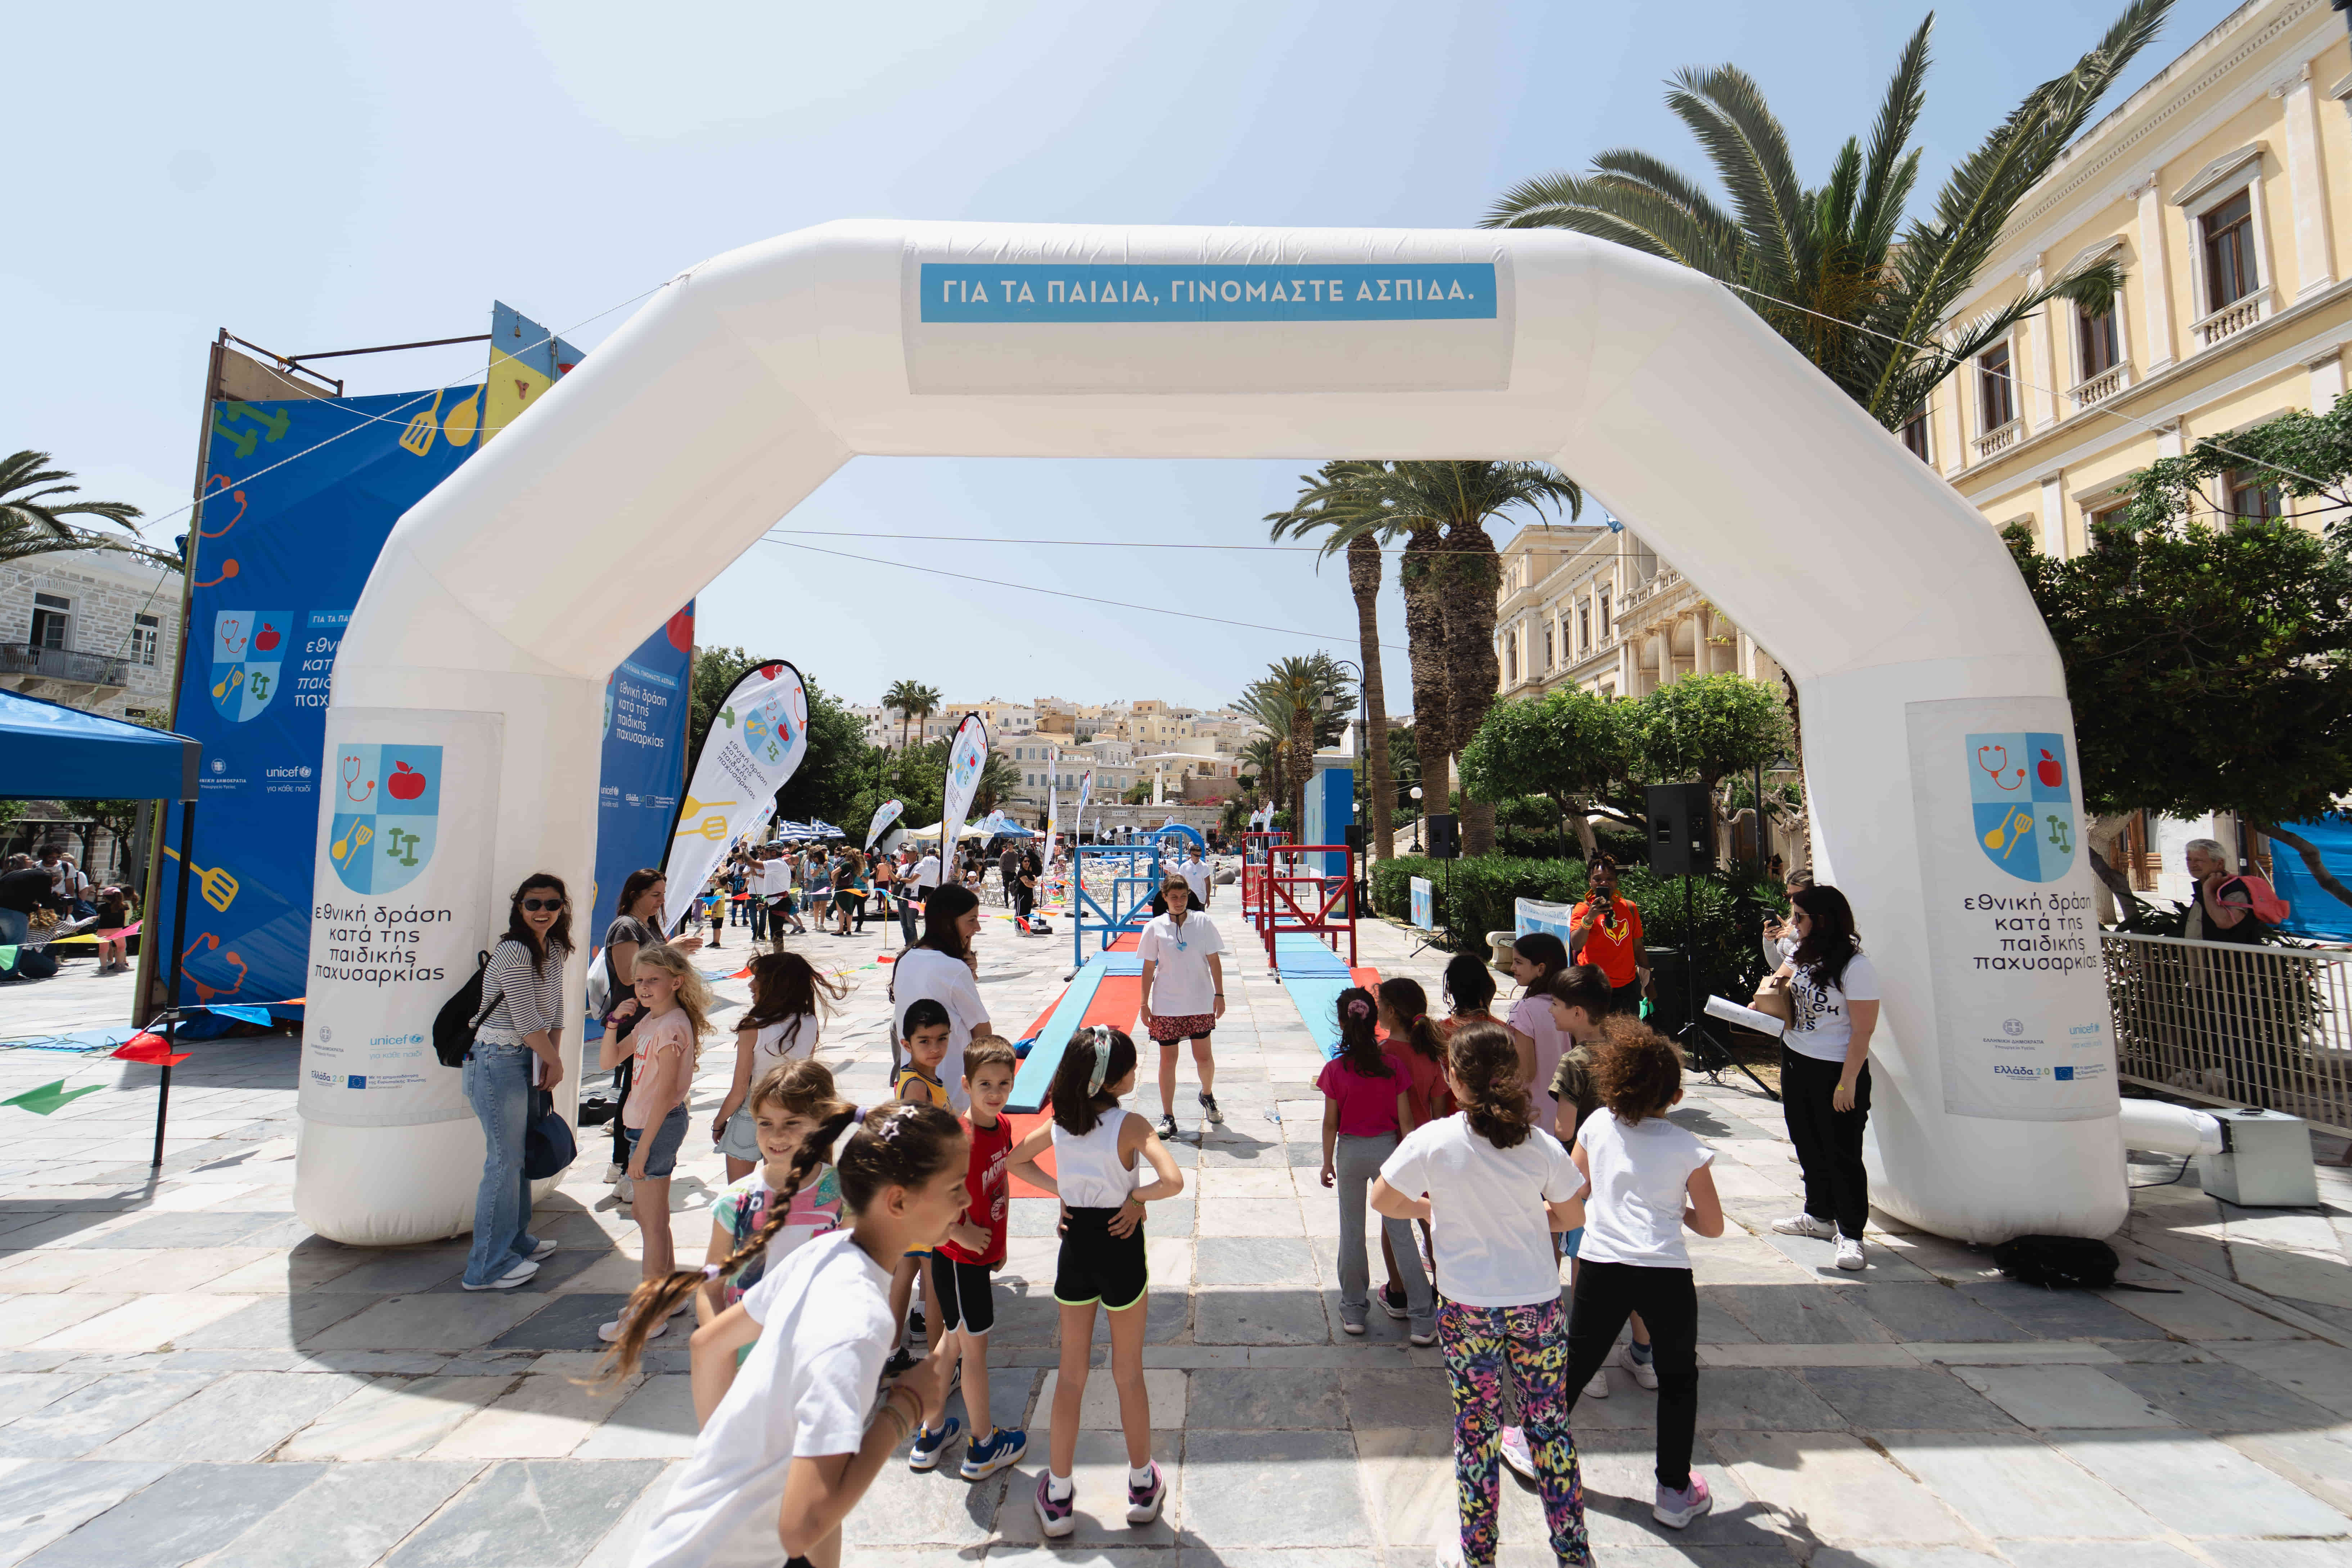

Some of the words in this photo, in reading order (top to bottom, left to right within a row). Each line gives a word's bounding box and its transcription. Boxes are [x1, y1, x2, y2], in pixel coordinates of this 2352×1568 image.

[943, 280, 989, 303] ΓΙΑ
[1000, 280, 1035, 303] ΤΑ
[1048, 281, 1159, 306] ΠΑΙΔΙΑ,
[1172, 280, 1344, 303] ΓΙΝΟΜΑΣΤΕ
[1355, 278, 1475, 301] ΑΣΠΙΔΑ.
[306, 637, 342, 653] εθνι
[302, 659, 333, 671] κατ
[297, 673, 332, 689] παιδ
[294, 694, 329, 707] παχ
[619, 681, 640, 699] εθνική
[642, 689, 667, 707] δράση
[618, 698, 634, 712] κατά
[636, 704, 649, 717] της
[617, 714, 646, 731] παιδικής
[616, 728, 664, 748] παχυσαρκίας
[721, 750, 747, 780] παιδικής
[725, 745, 742, 763] κατά
[742, 763, 753, 776] της
[729, 740, 749, 763] εθνική
[749, 763, 767, 786] δράση
[266, 766, 299, 777] unicef
[717, 755, 756, 799] παχυσαρκίας
[1964, 892, 2042, 911] εθνική
[2049, 891, 2091, 915] δράση
[315, 904, 366, 922] εθνική
[374, 904, 451, 928] δράση
[1995, 912, 2050, 931] κατά
[2058, 916, 2083, 931] της
[329, 924, 371, 943] κατά
[380, 929, 420, 943] της
[2000, 932, 2085, 951] παιδικής
[329, 945, 416, 964] παιδικής
[1973, 951, 2097, 976] παχυσαρκίας
[315, 962, 445, 987] παχυσαρκίας
[2069, 1023, 2094, 1035] unicef
[370, 1034, 408, 1045] unicef
[311, 1070, 331, 1081] Ελλάδα
[1994, 1065, 2034, 1075] Ελλάδα
